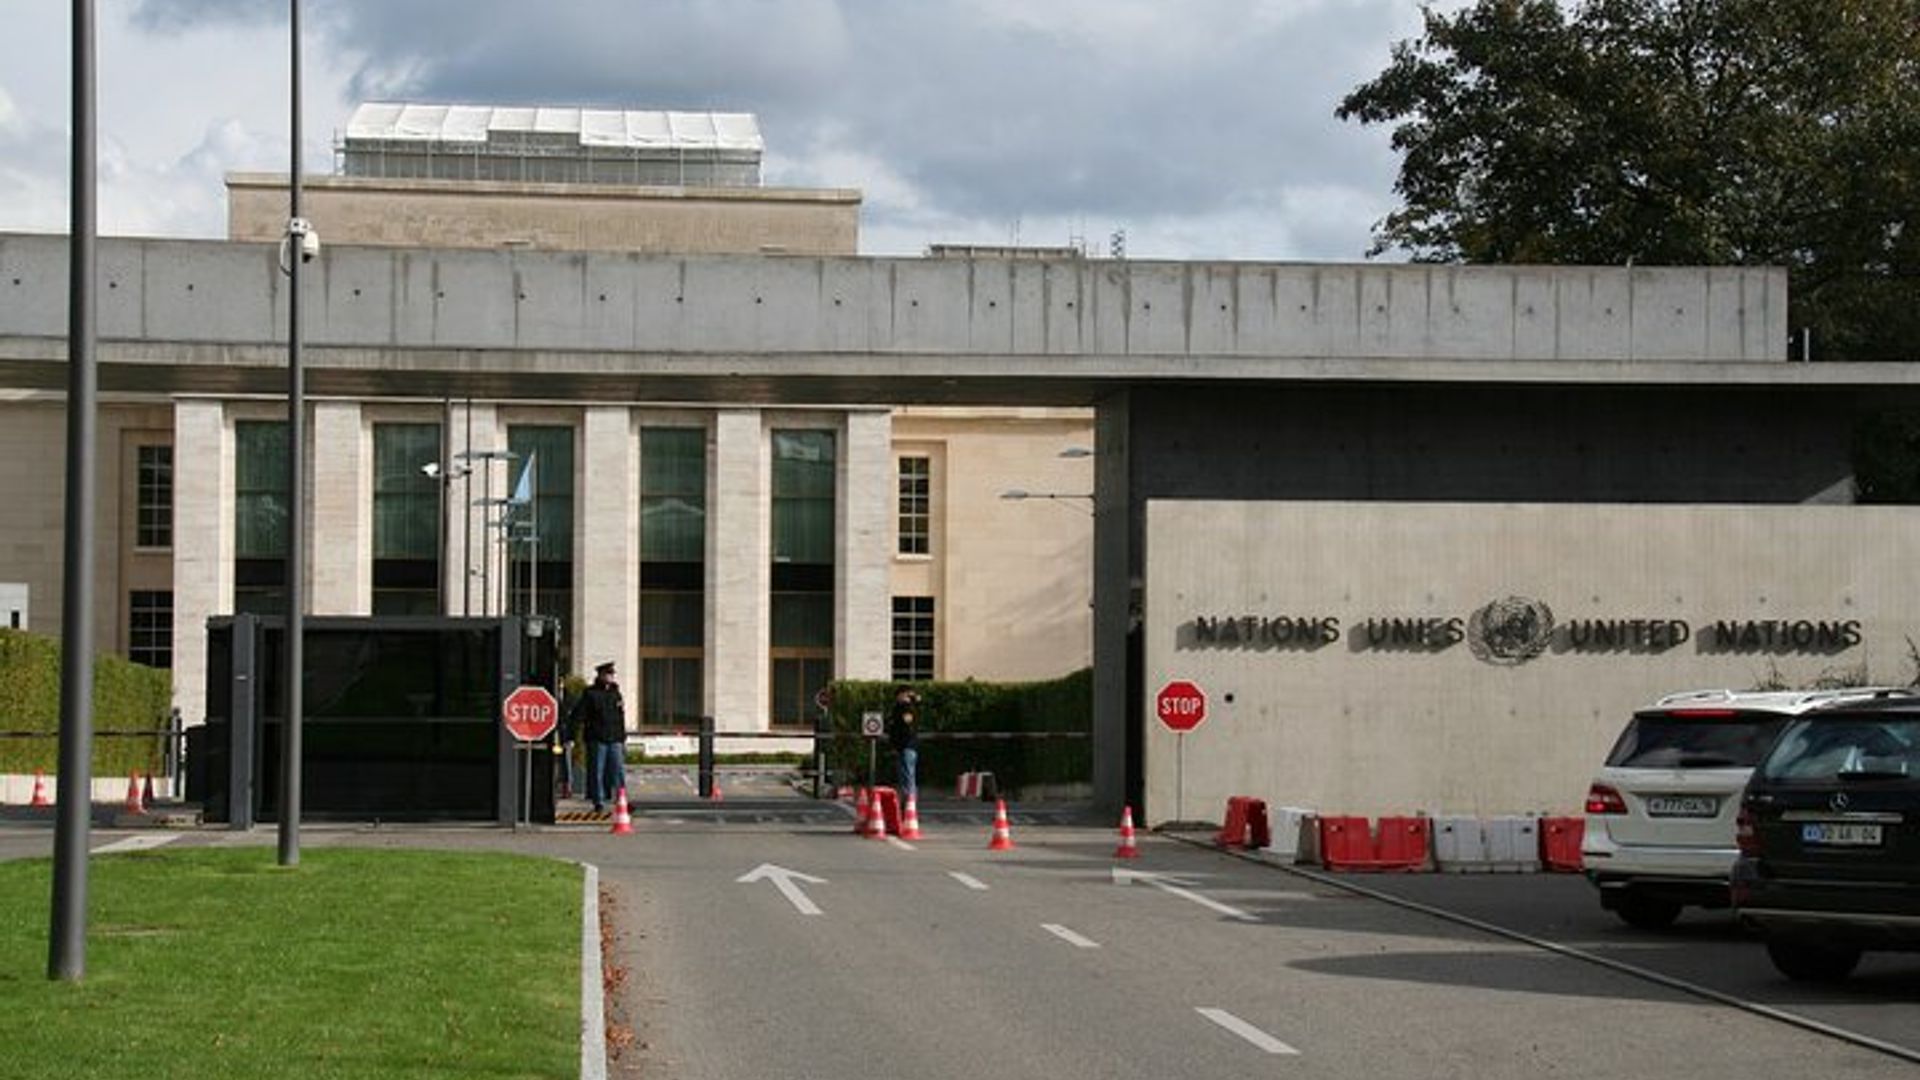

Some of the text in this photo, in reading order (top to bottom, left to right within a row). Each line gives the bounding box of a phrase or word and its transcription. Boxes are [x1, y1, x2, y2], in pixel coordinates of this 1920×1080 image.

[1196, 615, 1862, 646] NATIONS UNIES UNITED NATIONS
[510, 703, 551, 722] STOP
[1161, 697, 1201, 715] STOP
